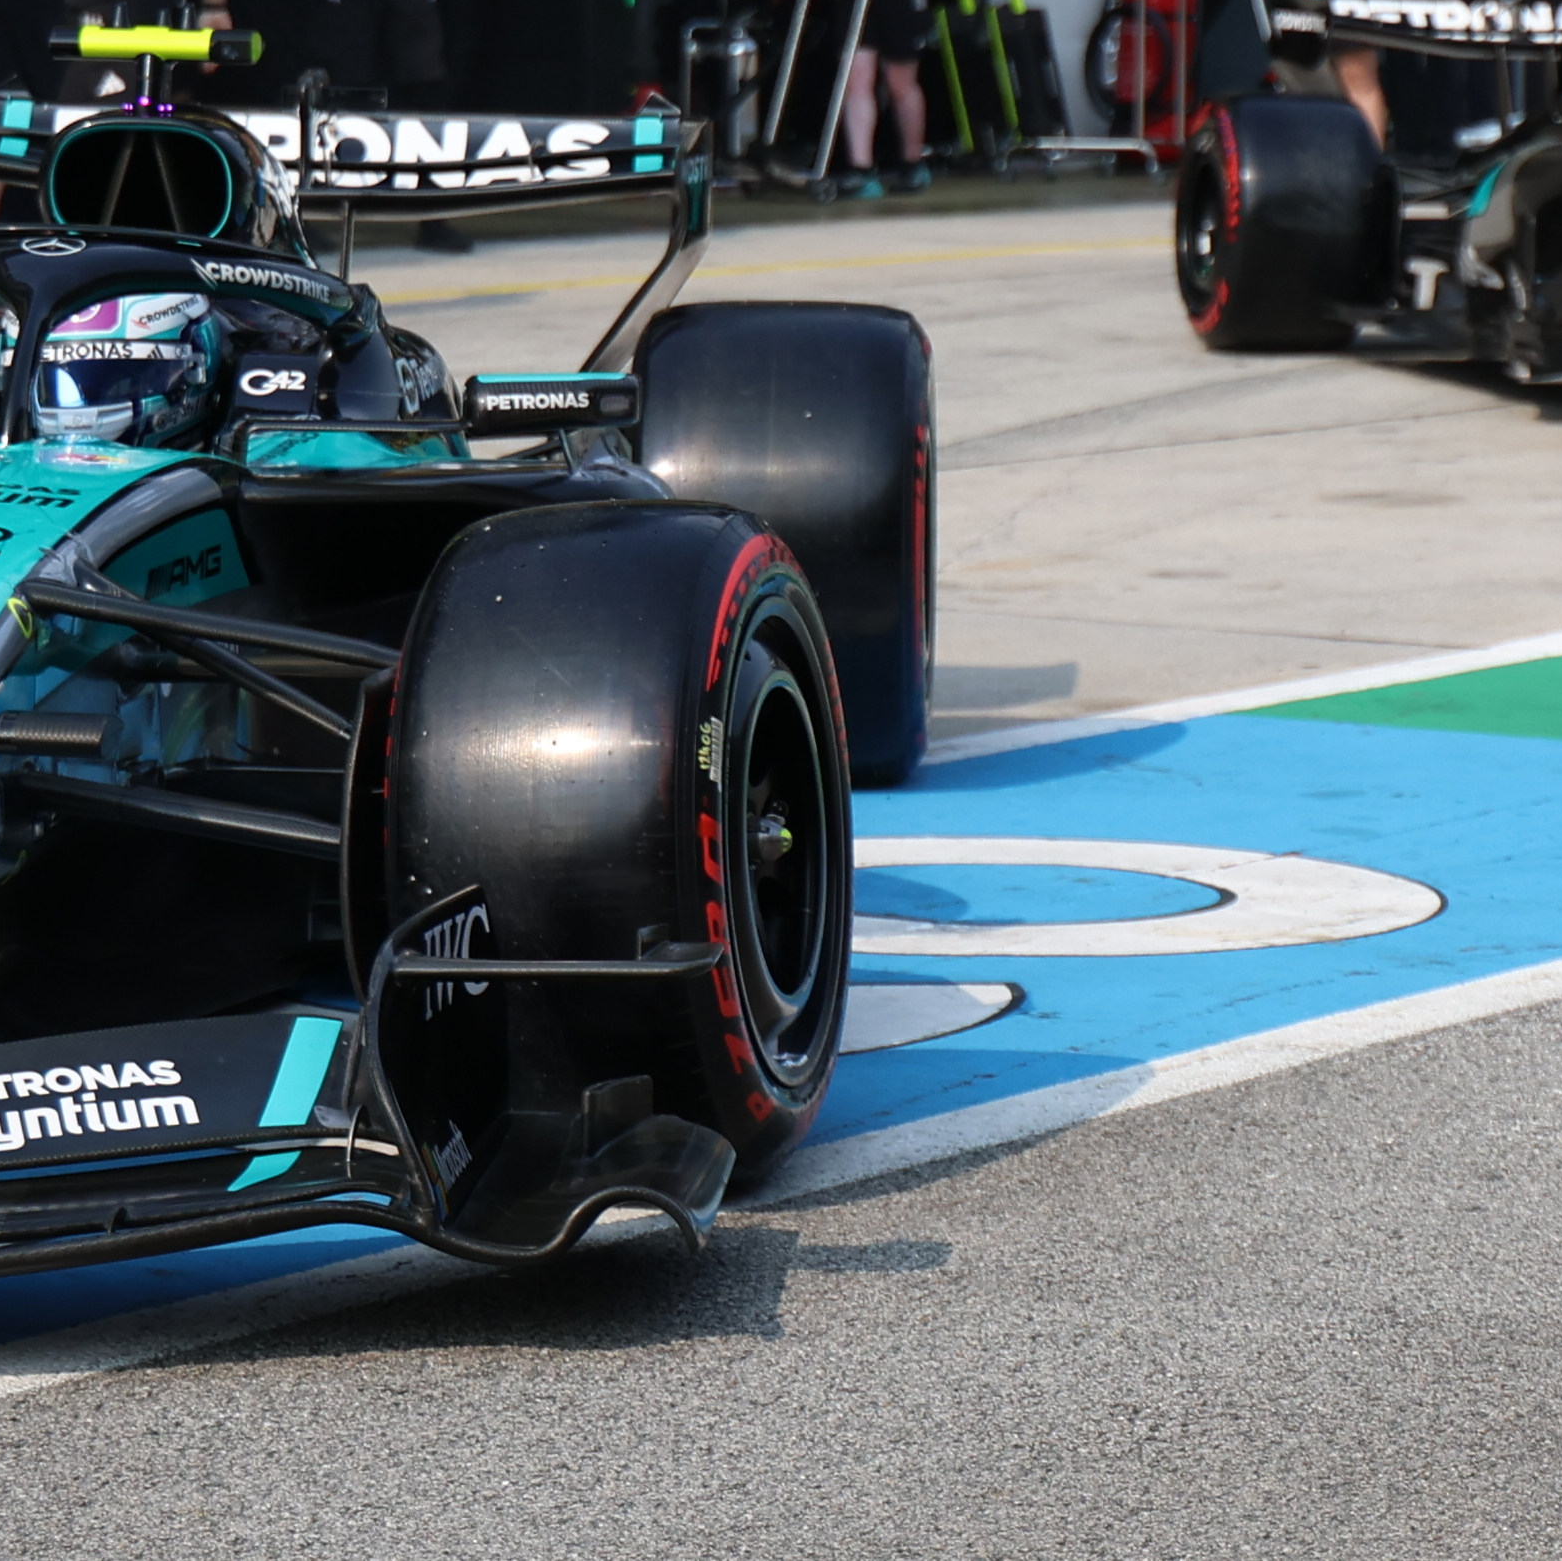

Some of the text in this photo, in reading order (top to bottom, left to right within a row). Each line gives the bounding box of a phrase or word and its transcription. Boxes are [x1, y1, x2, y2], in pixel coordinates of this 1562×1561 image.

[205, 261, 331, 304] CROWDSTRIKE
[139, 294, 201, 327] CROWDSTRIKE
[239, 368, 307, 397] G42
[486, 392, 591, 412] PETRONAS
[168, 545, 222, 593] AMG
[424, 902, 491, 1022] IWC
